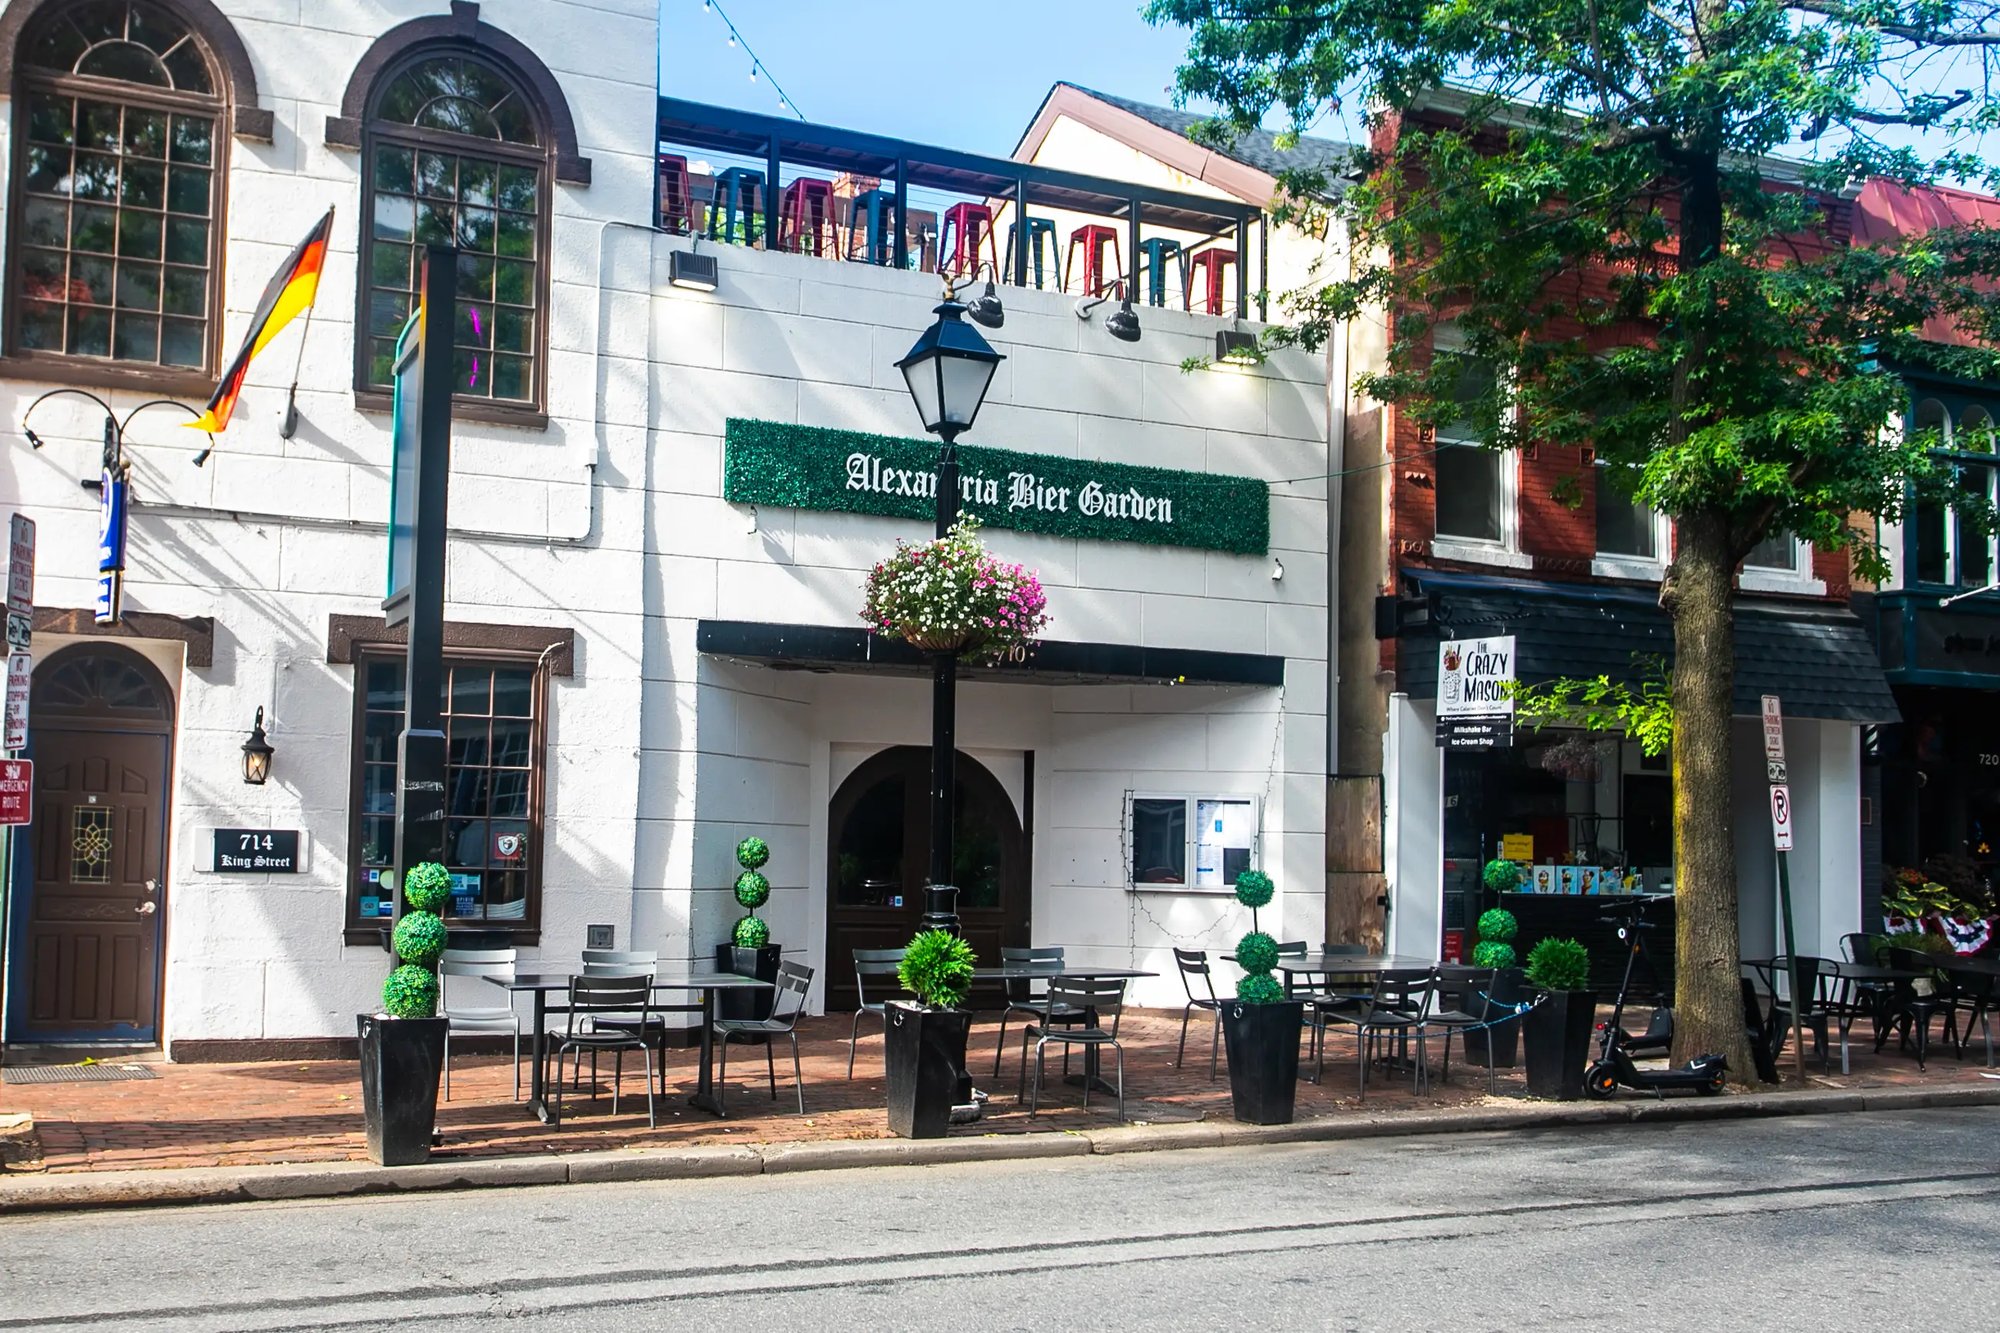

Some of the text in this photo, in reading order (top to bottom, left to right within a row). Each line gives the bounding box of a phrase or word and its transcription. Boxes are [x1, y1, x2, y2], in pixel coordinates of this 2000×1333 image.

[846, 453, 1174, 524] Alexanria Bier Garden
[12, 541, 33, 562] PARKING
[1477, 641, 1487, 654] THE
[1466, 650, 1508, 677] CRAZY
[9, 674, 28, 687] PARKING
[1481, 725, 1492, 733] Bar
[1460, 738, 1478, 746] Cream
[1478, 738, 1494, 746] Shop
[1979, 753, 2000, 766] 720
[0, 779, 29, 792] MERGENCY
[2, 796, 21, 809] ROUTE
[240, 833, 274, 851] 714
[221, 853, 290, 869] King Street
